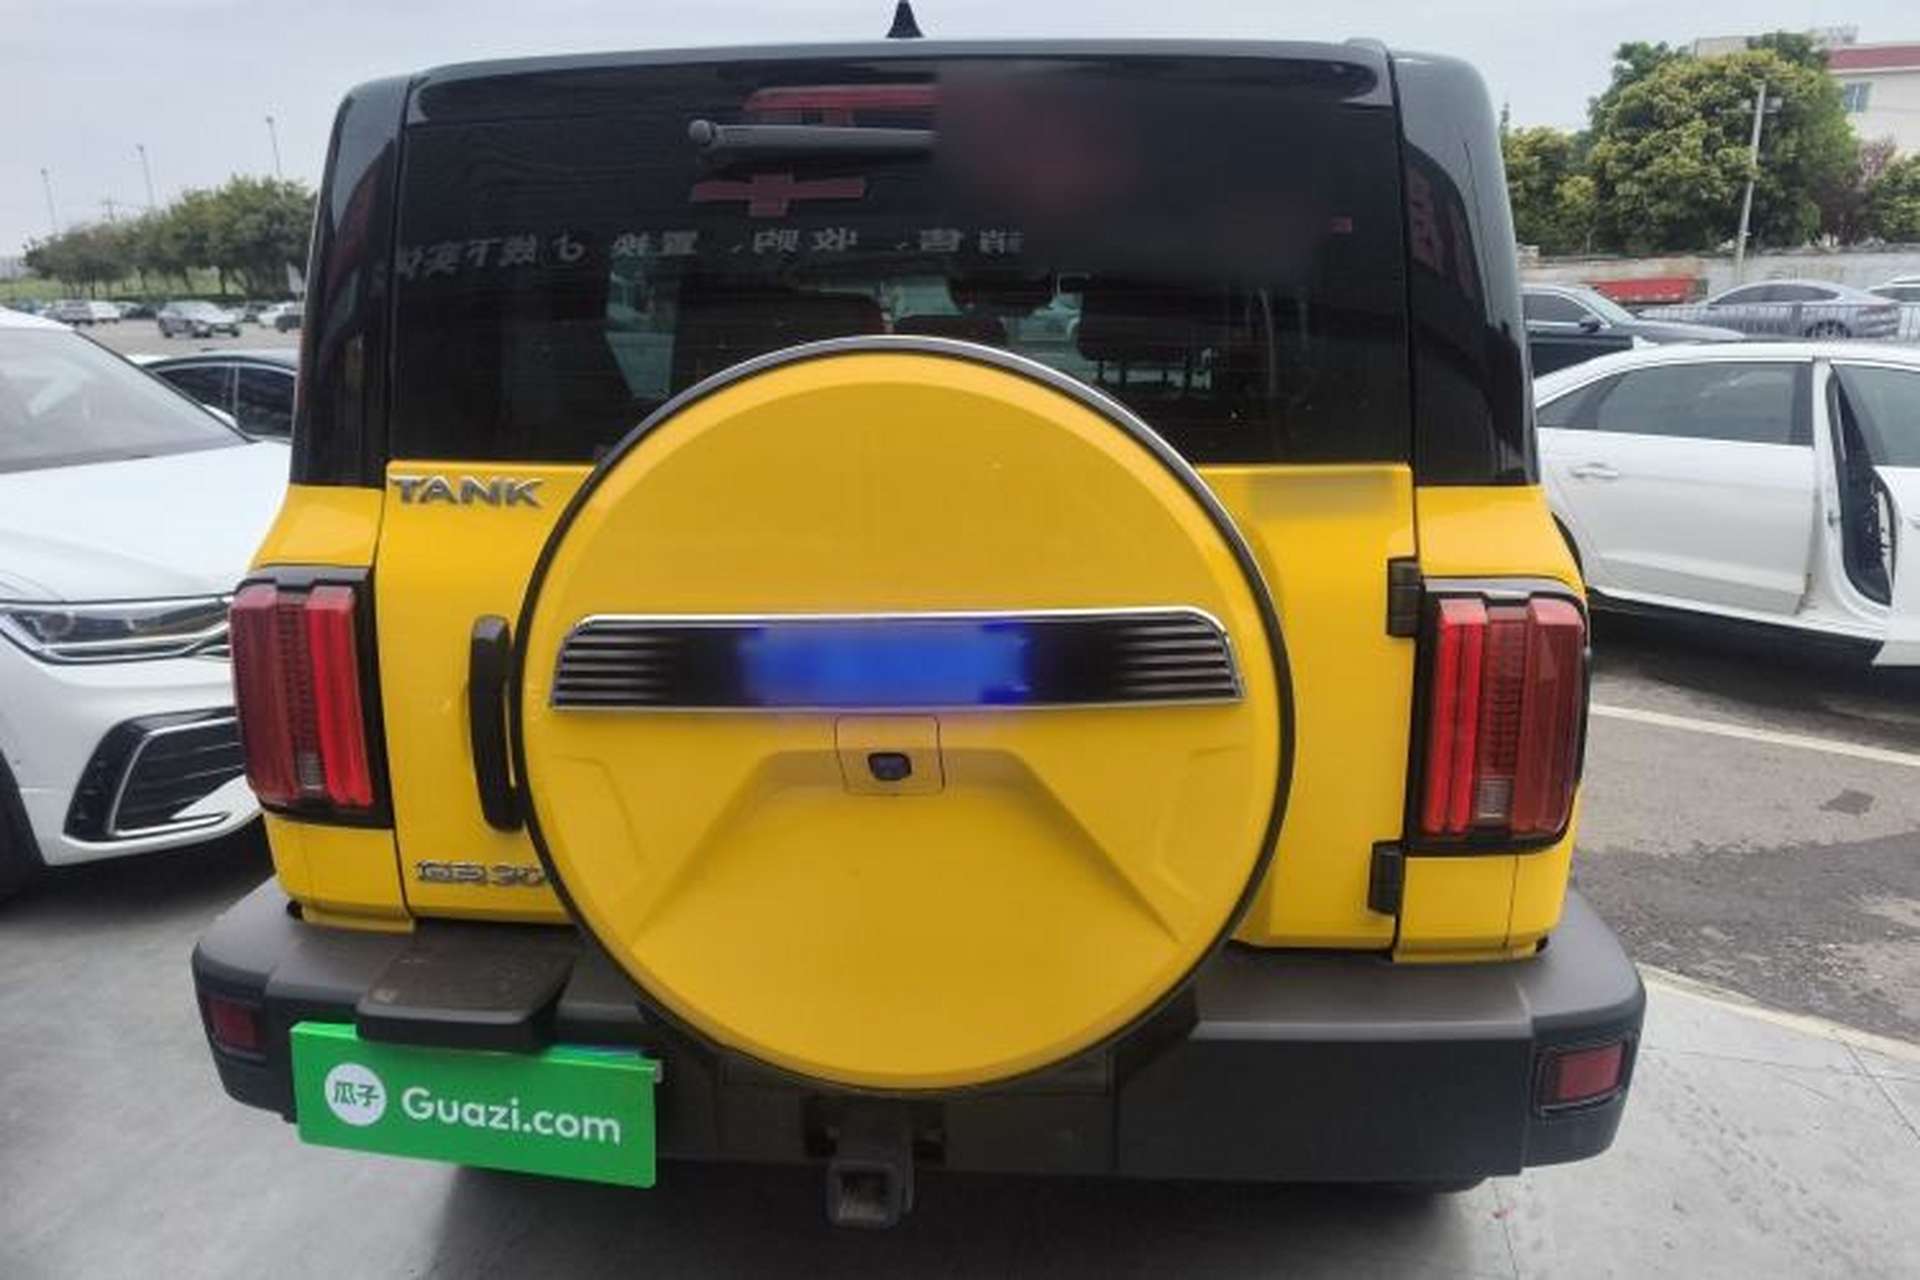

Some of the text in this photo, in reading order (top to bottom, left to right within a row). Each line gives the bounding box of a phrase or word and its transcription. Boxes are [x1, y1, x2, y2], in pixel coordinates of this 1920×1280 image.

[387, 473, 544, 509] TANK
[333, 1081, 622, 1146] 瓜子 Guazi.com
